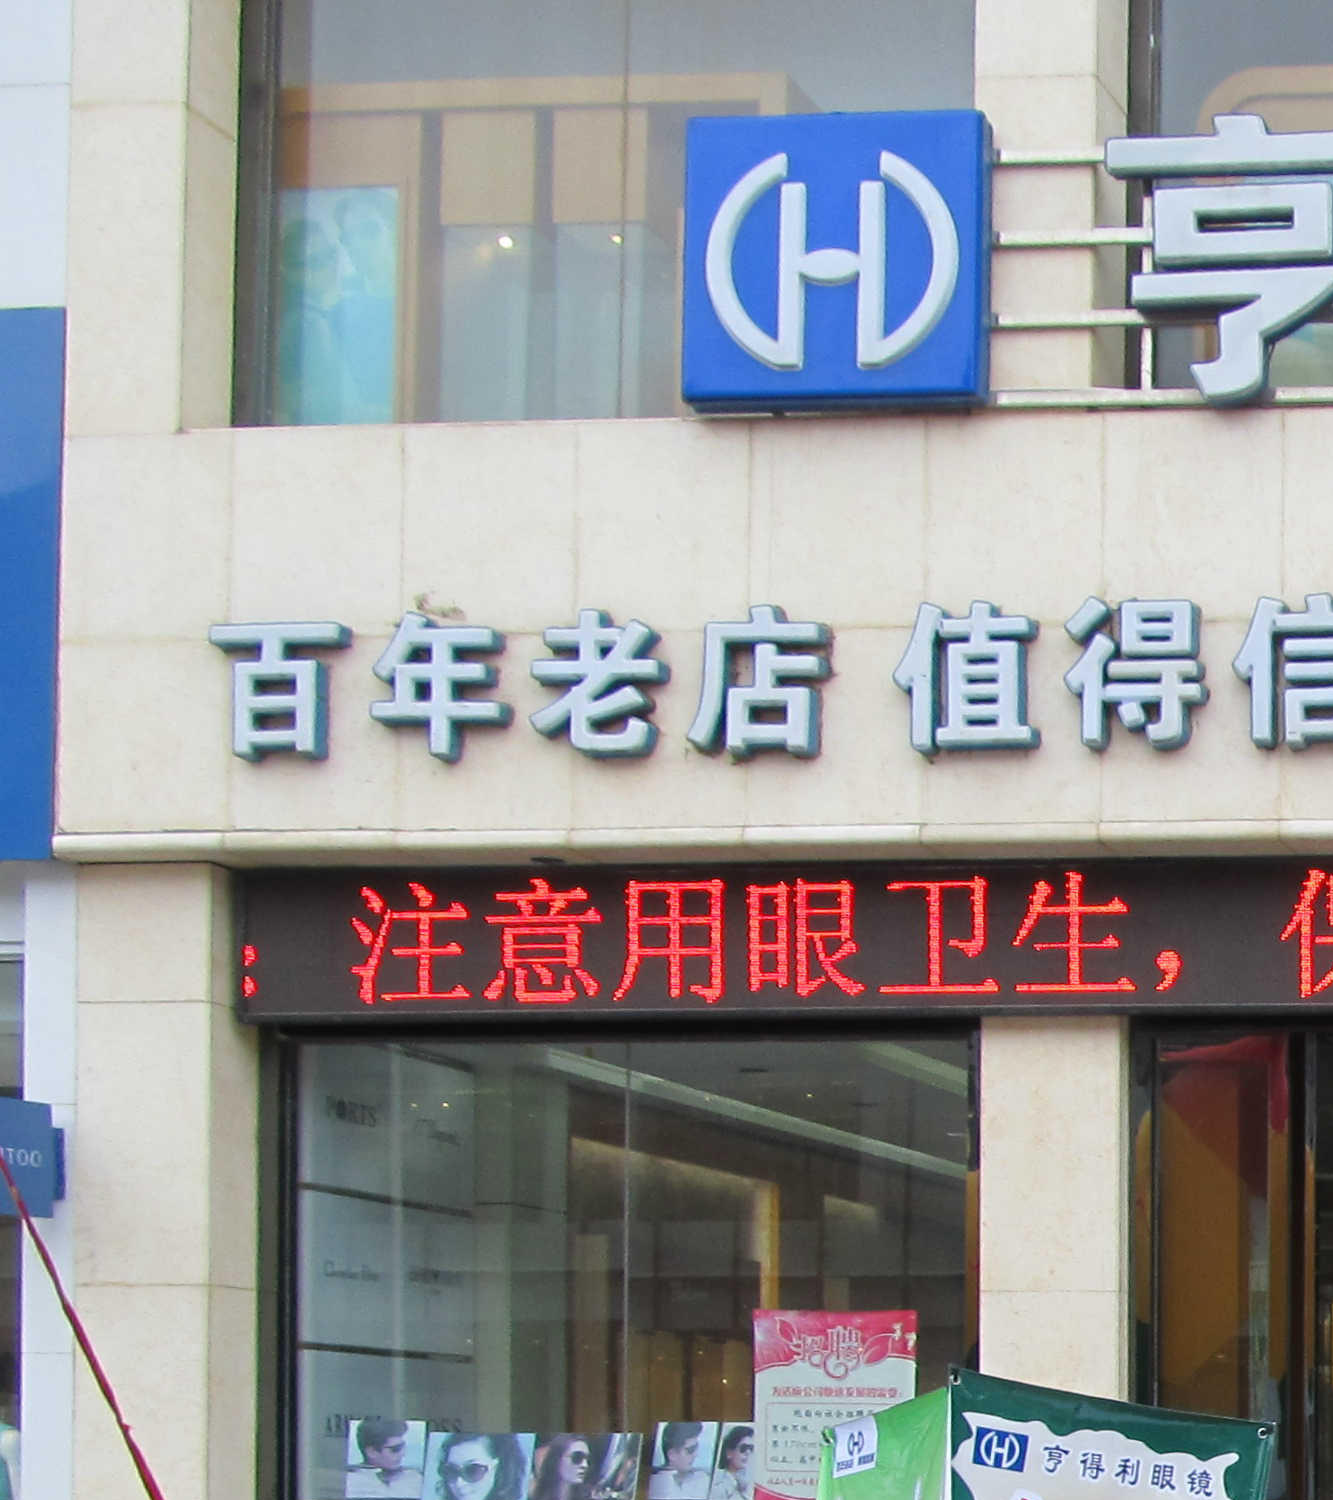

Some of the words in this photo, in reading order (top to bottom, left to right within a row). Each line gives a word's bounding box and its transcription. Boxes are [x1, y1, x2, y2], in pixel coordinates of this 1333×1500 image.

[209, 603, 834, 764] 百年老店
[1042, 1443, 1214, 1498] 亨得利眼镜
